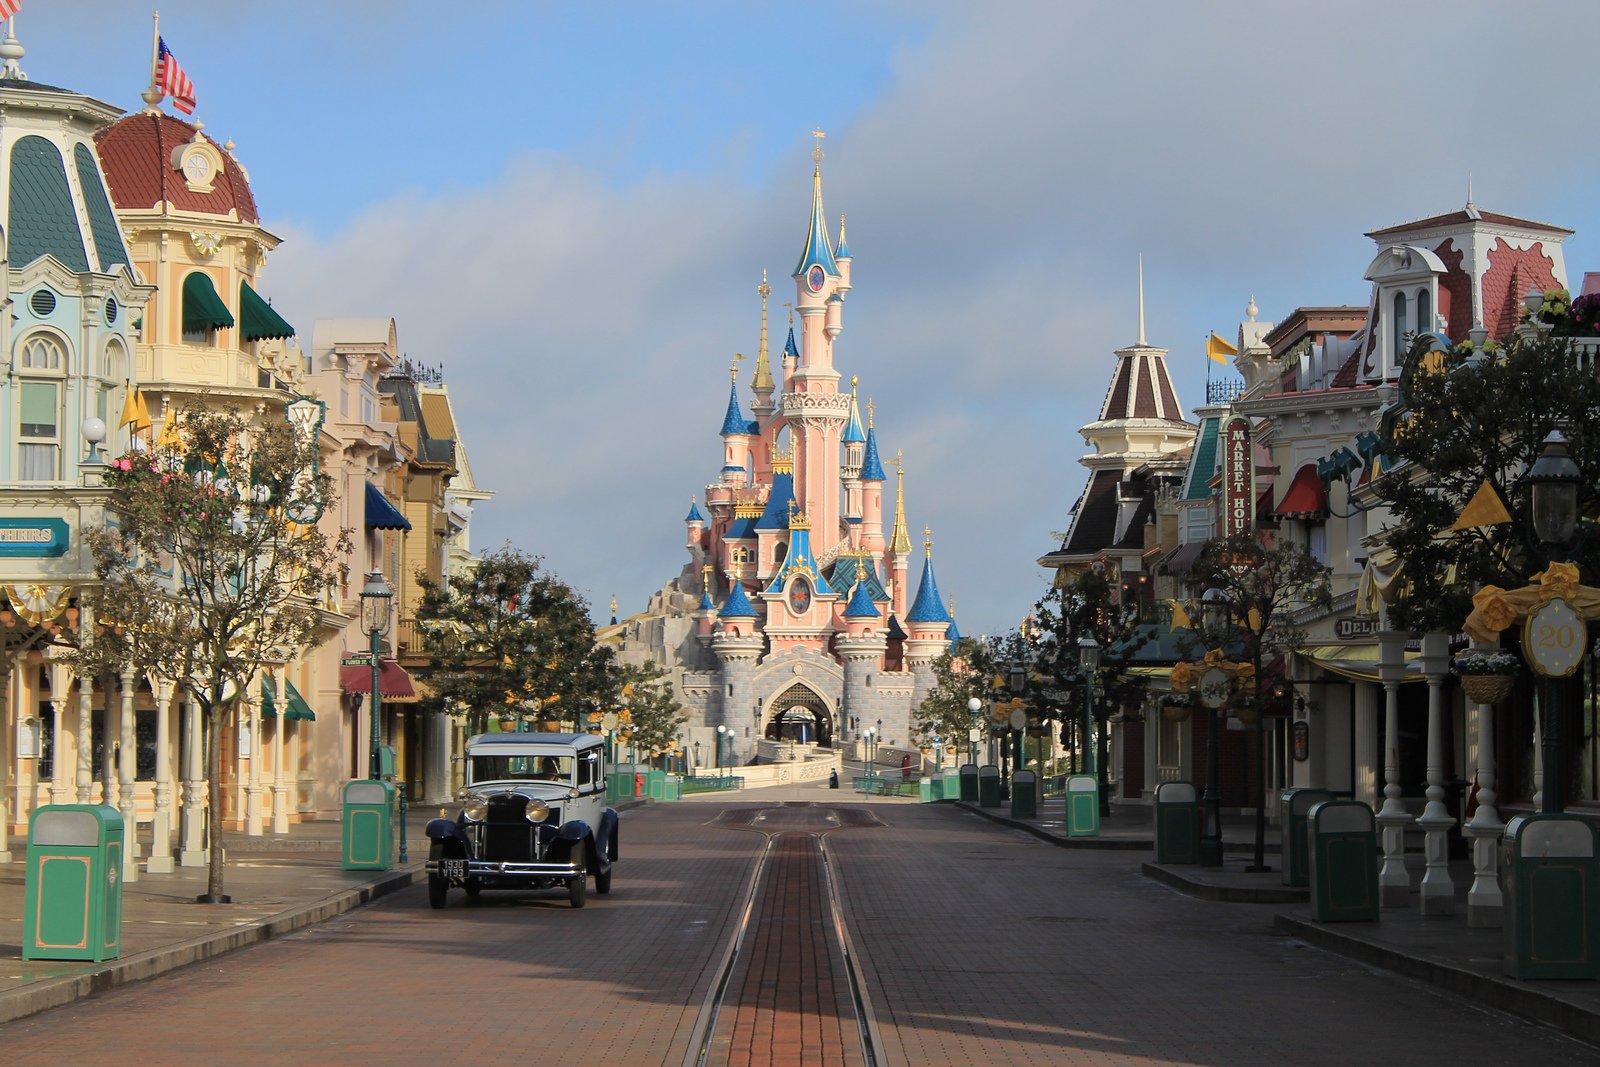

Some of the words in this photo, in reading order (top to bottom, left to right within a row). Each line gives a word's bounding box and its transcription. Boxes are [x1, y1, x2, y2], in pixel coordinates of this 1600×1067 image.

[1232, 430, 1246, 493] MARKET
[1538, 623, 1576, 649] 20
[444, 860, 464, 869] 1930
